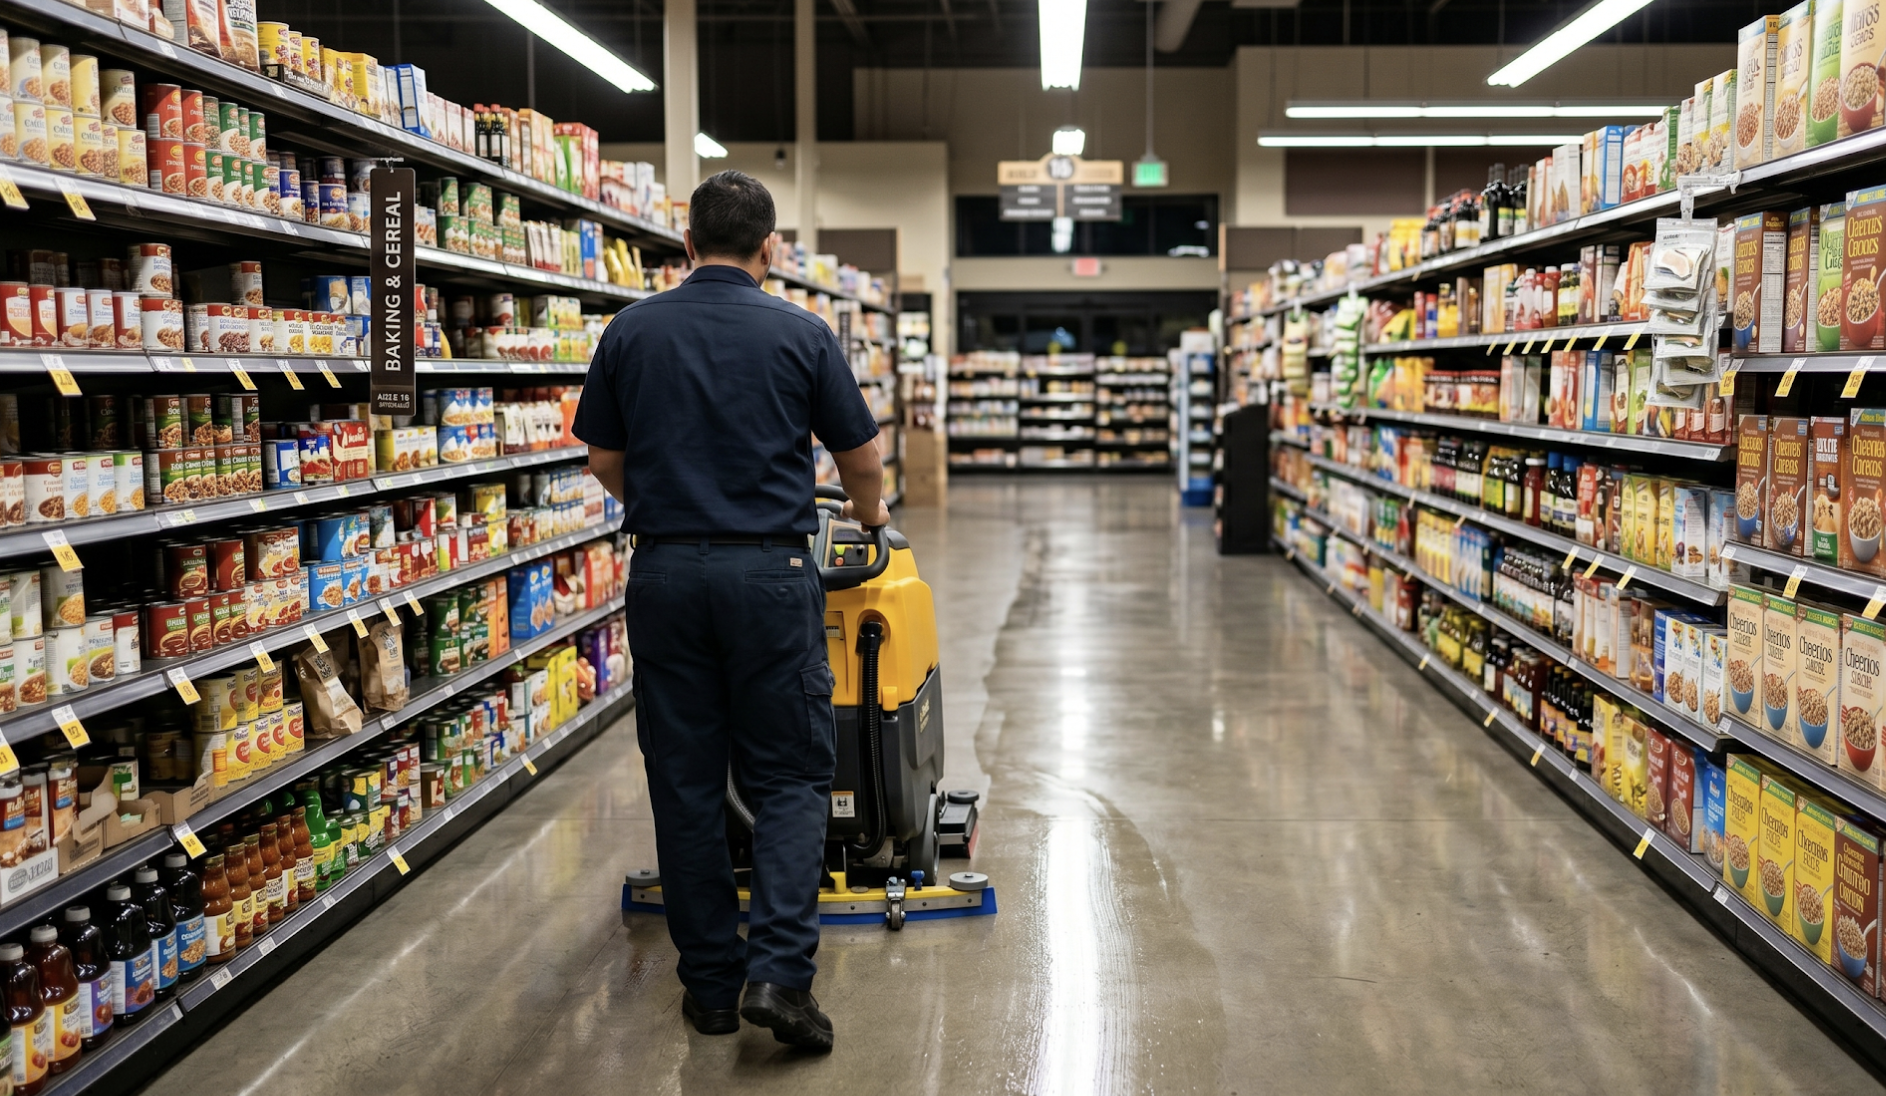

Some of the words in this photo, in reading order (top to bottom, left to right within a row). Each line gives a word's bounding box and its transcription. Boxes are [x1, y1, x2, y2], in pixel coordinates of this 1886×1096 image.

[385, 191, 401, 269] CEREAL
[385, 274, 401, 289] &
[385, 294, 401, 372] BAKING
[1729, 611, 1757, 636] Cheerios
[1764, 623, 1791, 650] Cheerios
[1799, 635, 1833, 664] Cheerios
[1845, 646, 1880, 677] Cheerios
